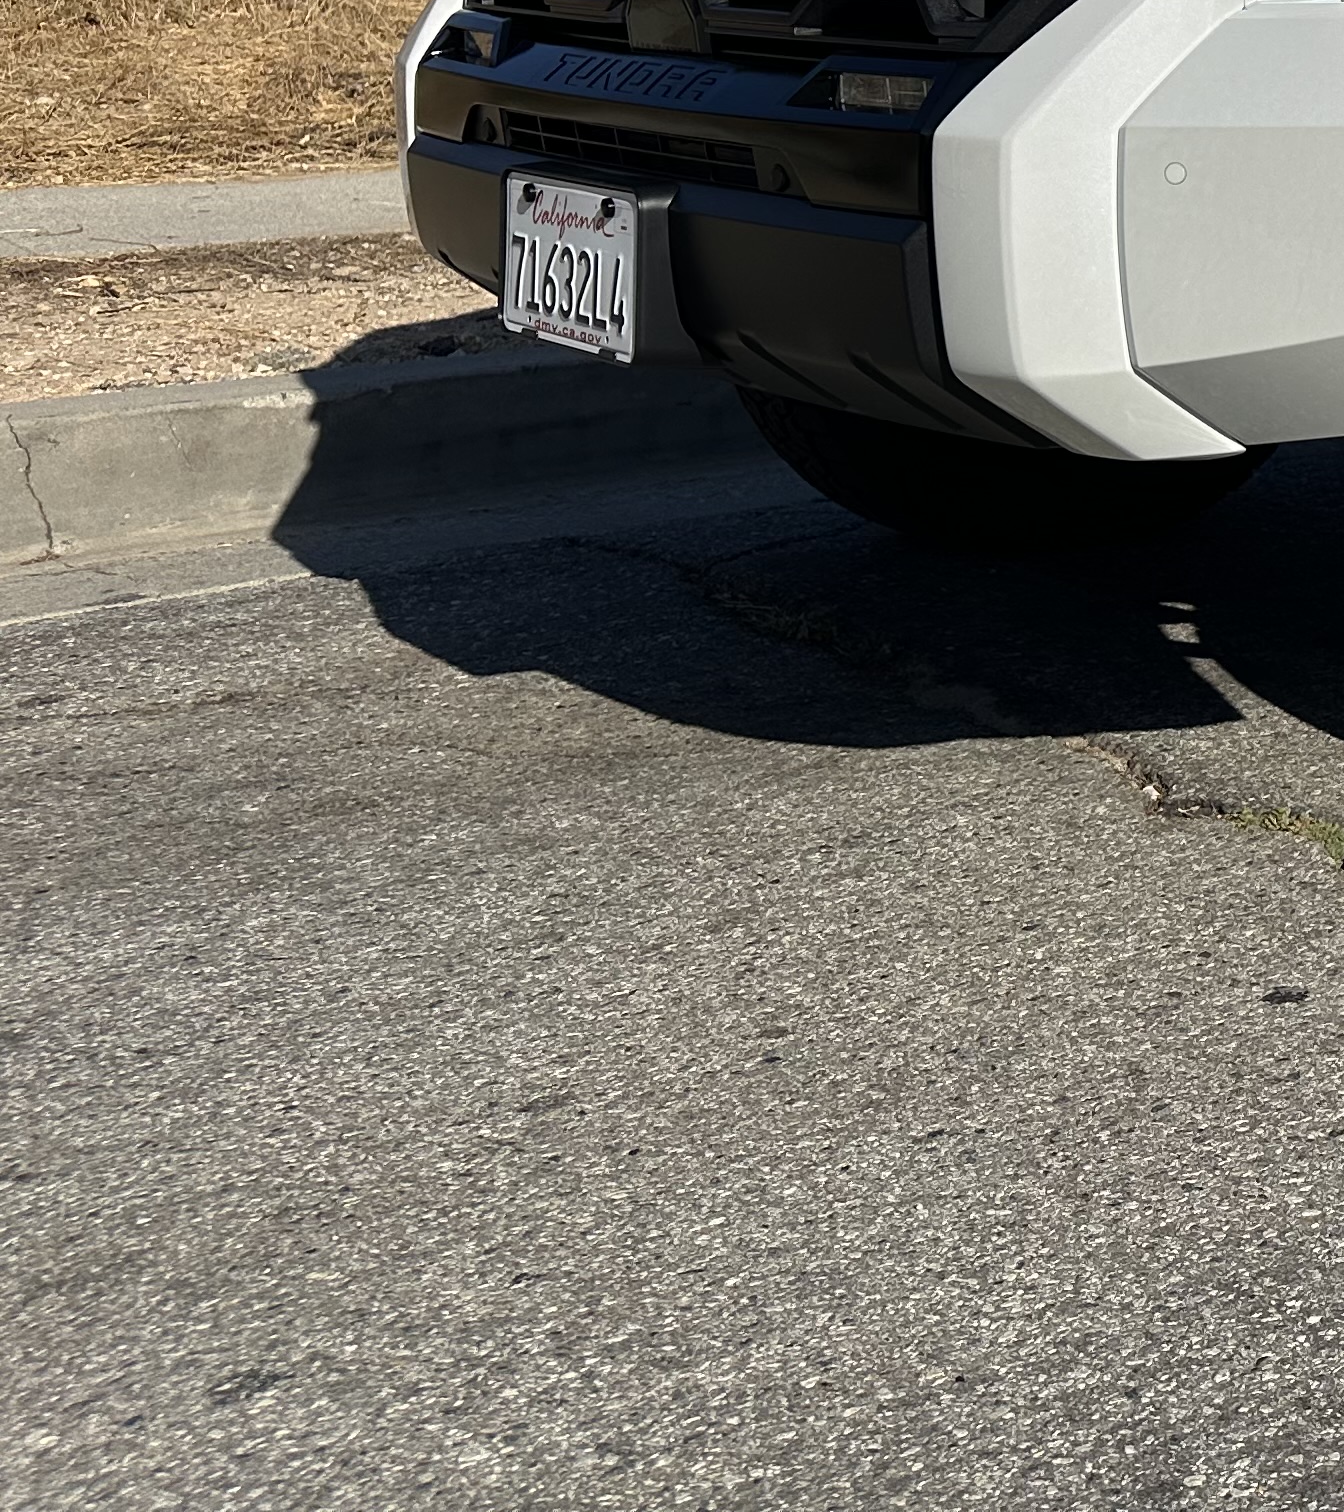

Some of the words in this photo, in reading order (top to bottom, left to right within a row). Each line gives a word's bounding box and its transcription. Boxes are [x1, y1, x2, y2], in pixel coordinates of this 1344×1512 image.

[543, 53, 728, 102] TUNDRA
[532, 189, 614, 240] California
[511, 234, 626, 337] 71632L4
[534, 319, 602, 344] dmv.ca.gov
